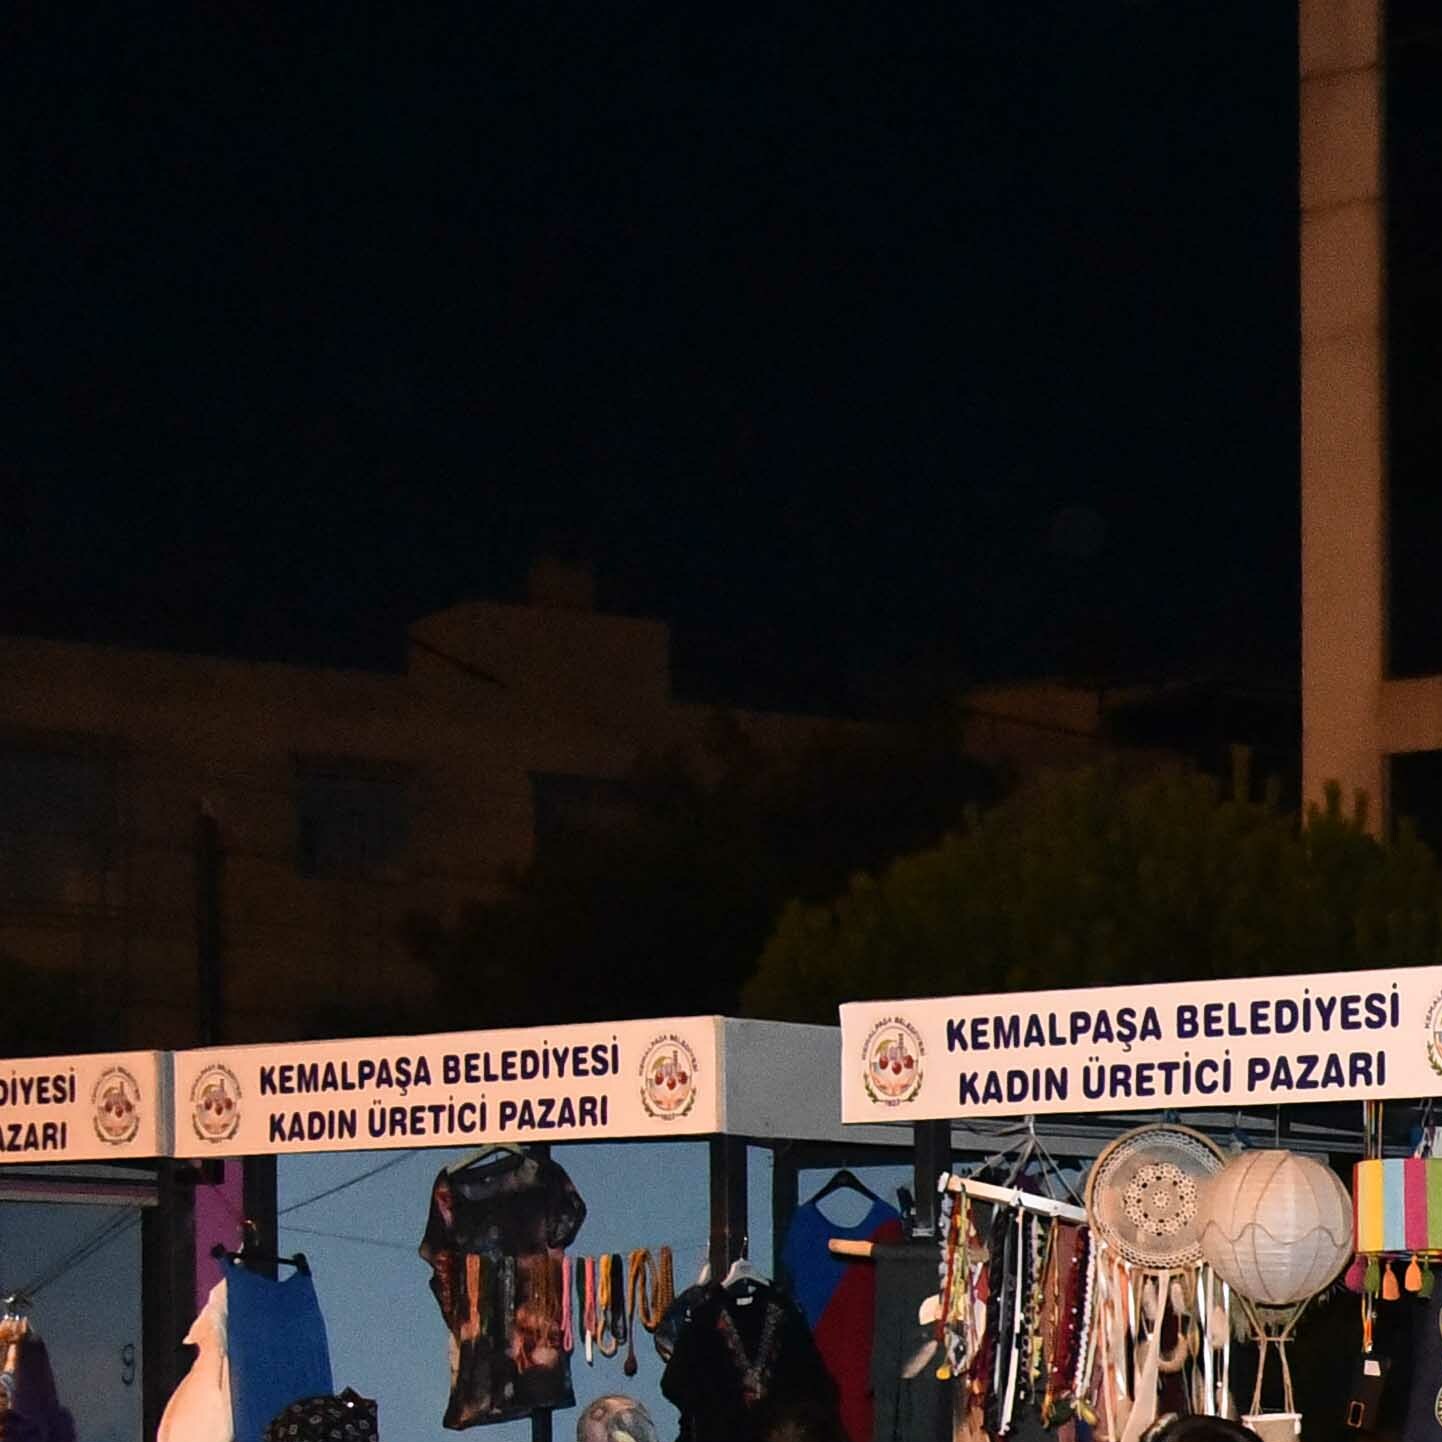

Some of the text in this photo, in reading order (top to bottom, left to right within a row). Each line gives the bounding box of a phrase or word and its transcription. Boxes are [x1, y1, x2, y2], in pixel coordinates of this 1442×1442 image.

[947, 983, 1399, 1052] KEMALPAŞA BELEDİYESİ
[260, 1056, 431, 1096] KEMALPAŞA
[443, 1036, 618, 1084] BELEDİYESİ
[960, 1050, 1385, 1105] KADIN ÜRETİCİ PAZARI
[270, 1094, 607, 1142] KADIN ÜRETİCİ PAZARI
